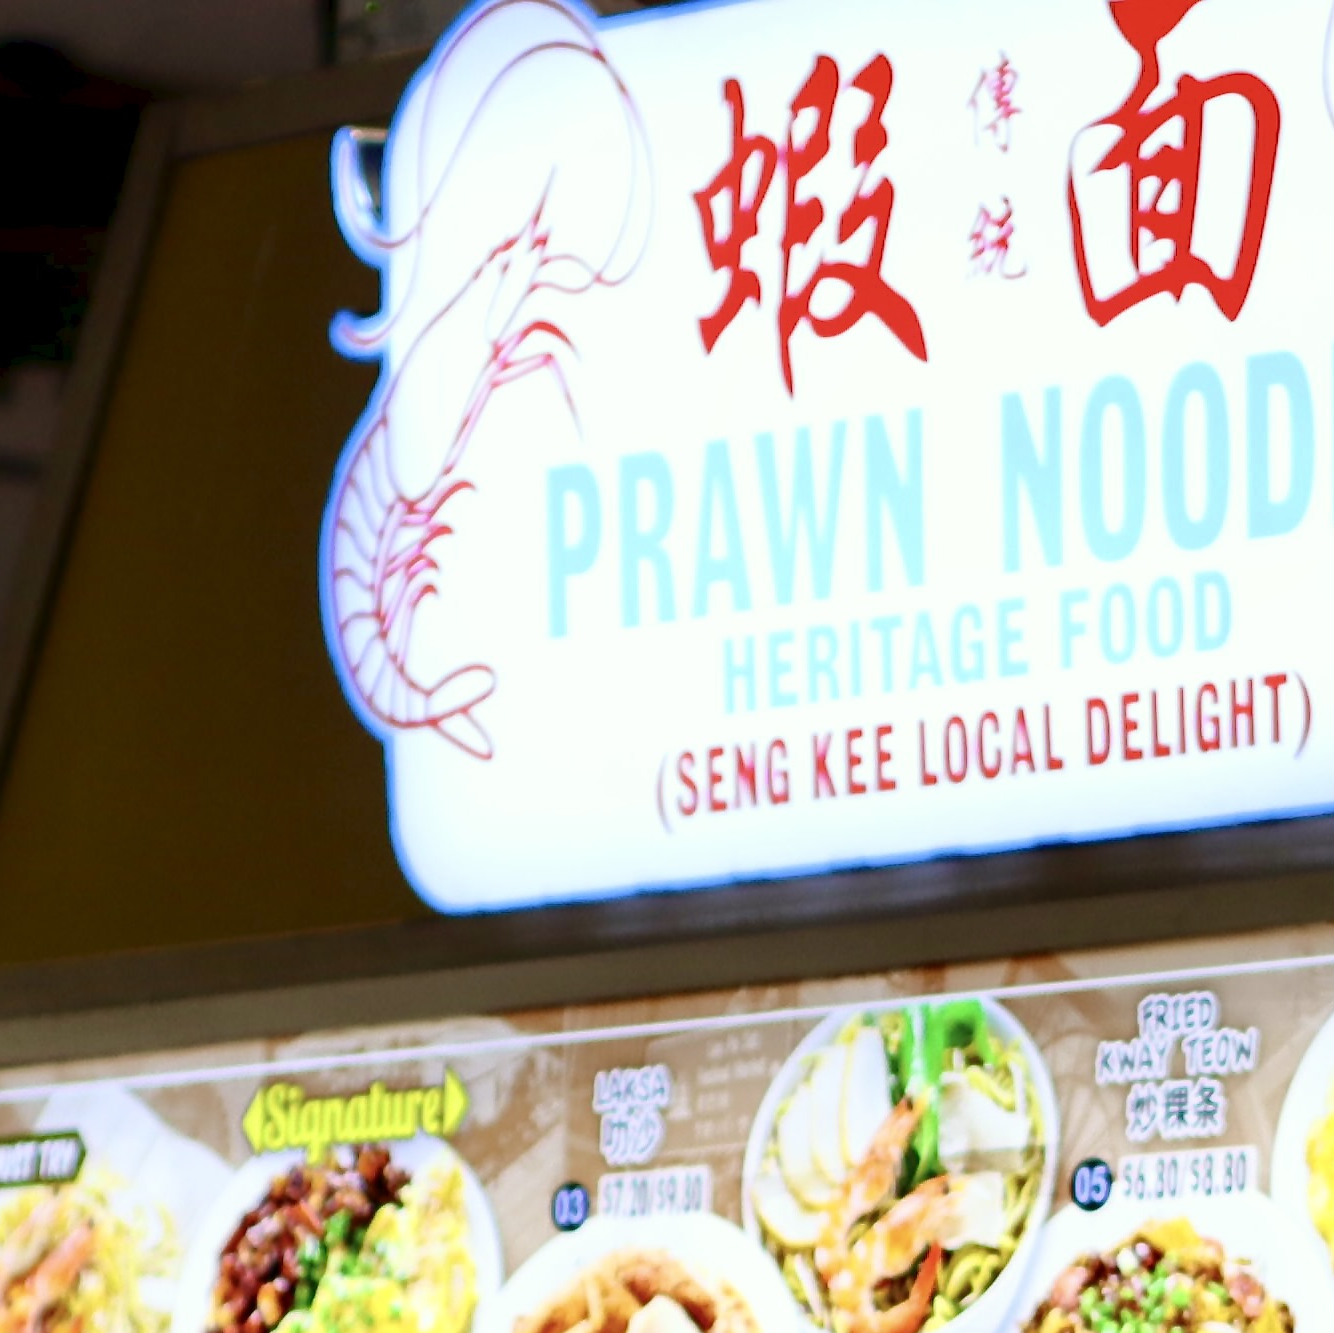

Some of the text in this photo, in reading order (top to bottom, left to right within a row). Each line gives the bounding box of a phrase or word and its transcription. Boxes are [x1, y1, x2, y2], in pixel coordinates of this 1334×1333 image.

[690, 0, 1282, 400] 蝦 面
[544, 405, 927, 640] PRAWN
[720, 569, 1234, 715] HERITAGE FOOD
[655, 671, 1313, 835] (SENG KEE LOCAL DELIGHT)
[1140, 994, 1214, 1033] FRIED
[1099, 1031, 1257, 1073] KWAY TEOW
[594, 1067, 669, 1108] LAKSA
[264, 1081, 443, 1169] Signature
[553, 1187, 587, 1226] 03
[1074, 1164, 1110, 1206] 05
